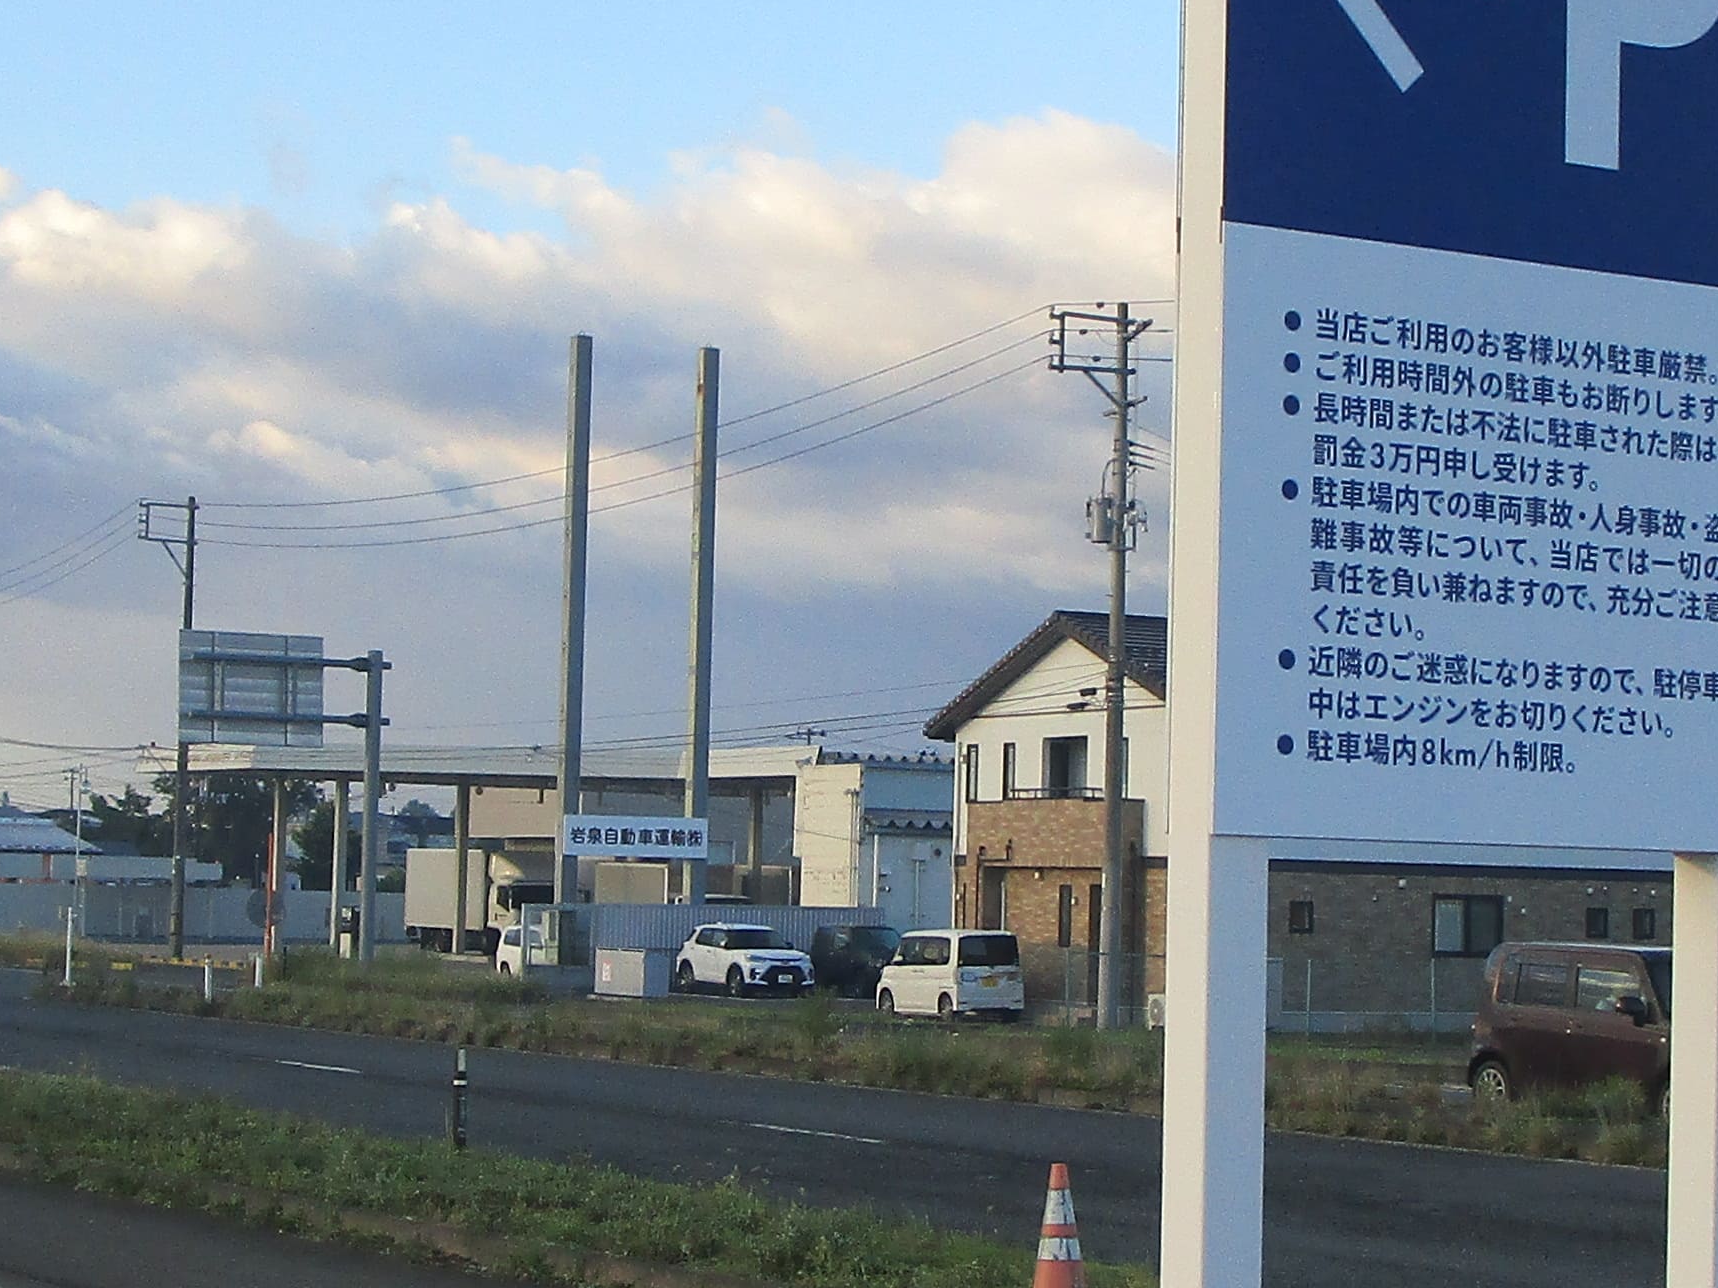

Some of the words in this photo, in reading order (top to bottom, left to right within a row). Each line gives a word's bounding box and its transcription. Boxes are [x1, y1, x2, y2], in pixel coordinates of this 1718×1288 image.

[1314, 308, 1717, 386] 当店ご利用のお客様以外駐車厳禁。
[1312, 434, 1599, 491] 罰金3万円申し受けます。
[1312, 604, 1426, 641] ください。
[1308, 687, 1674, 738] 中はエンジンをお切りください。
[1306, 729, 1577, 773] 駐車場内8km/h制限。
